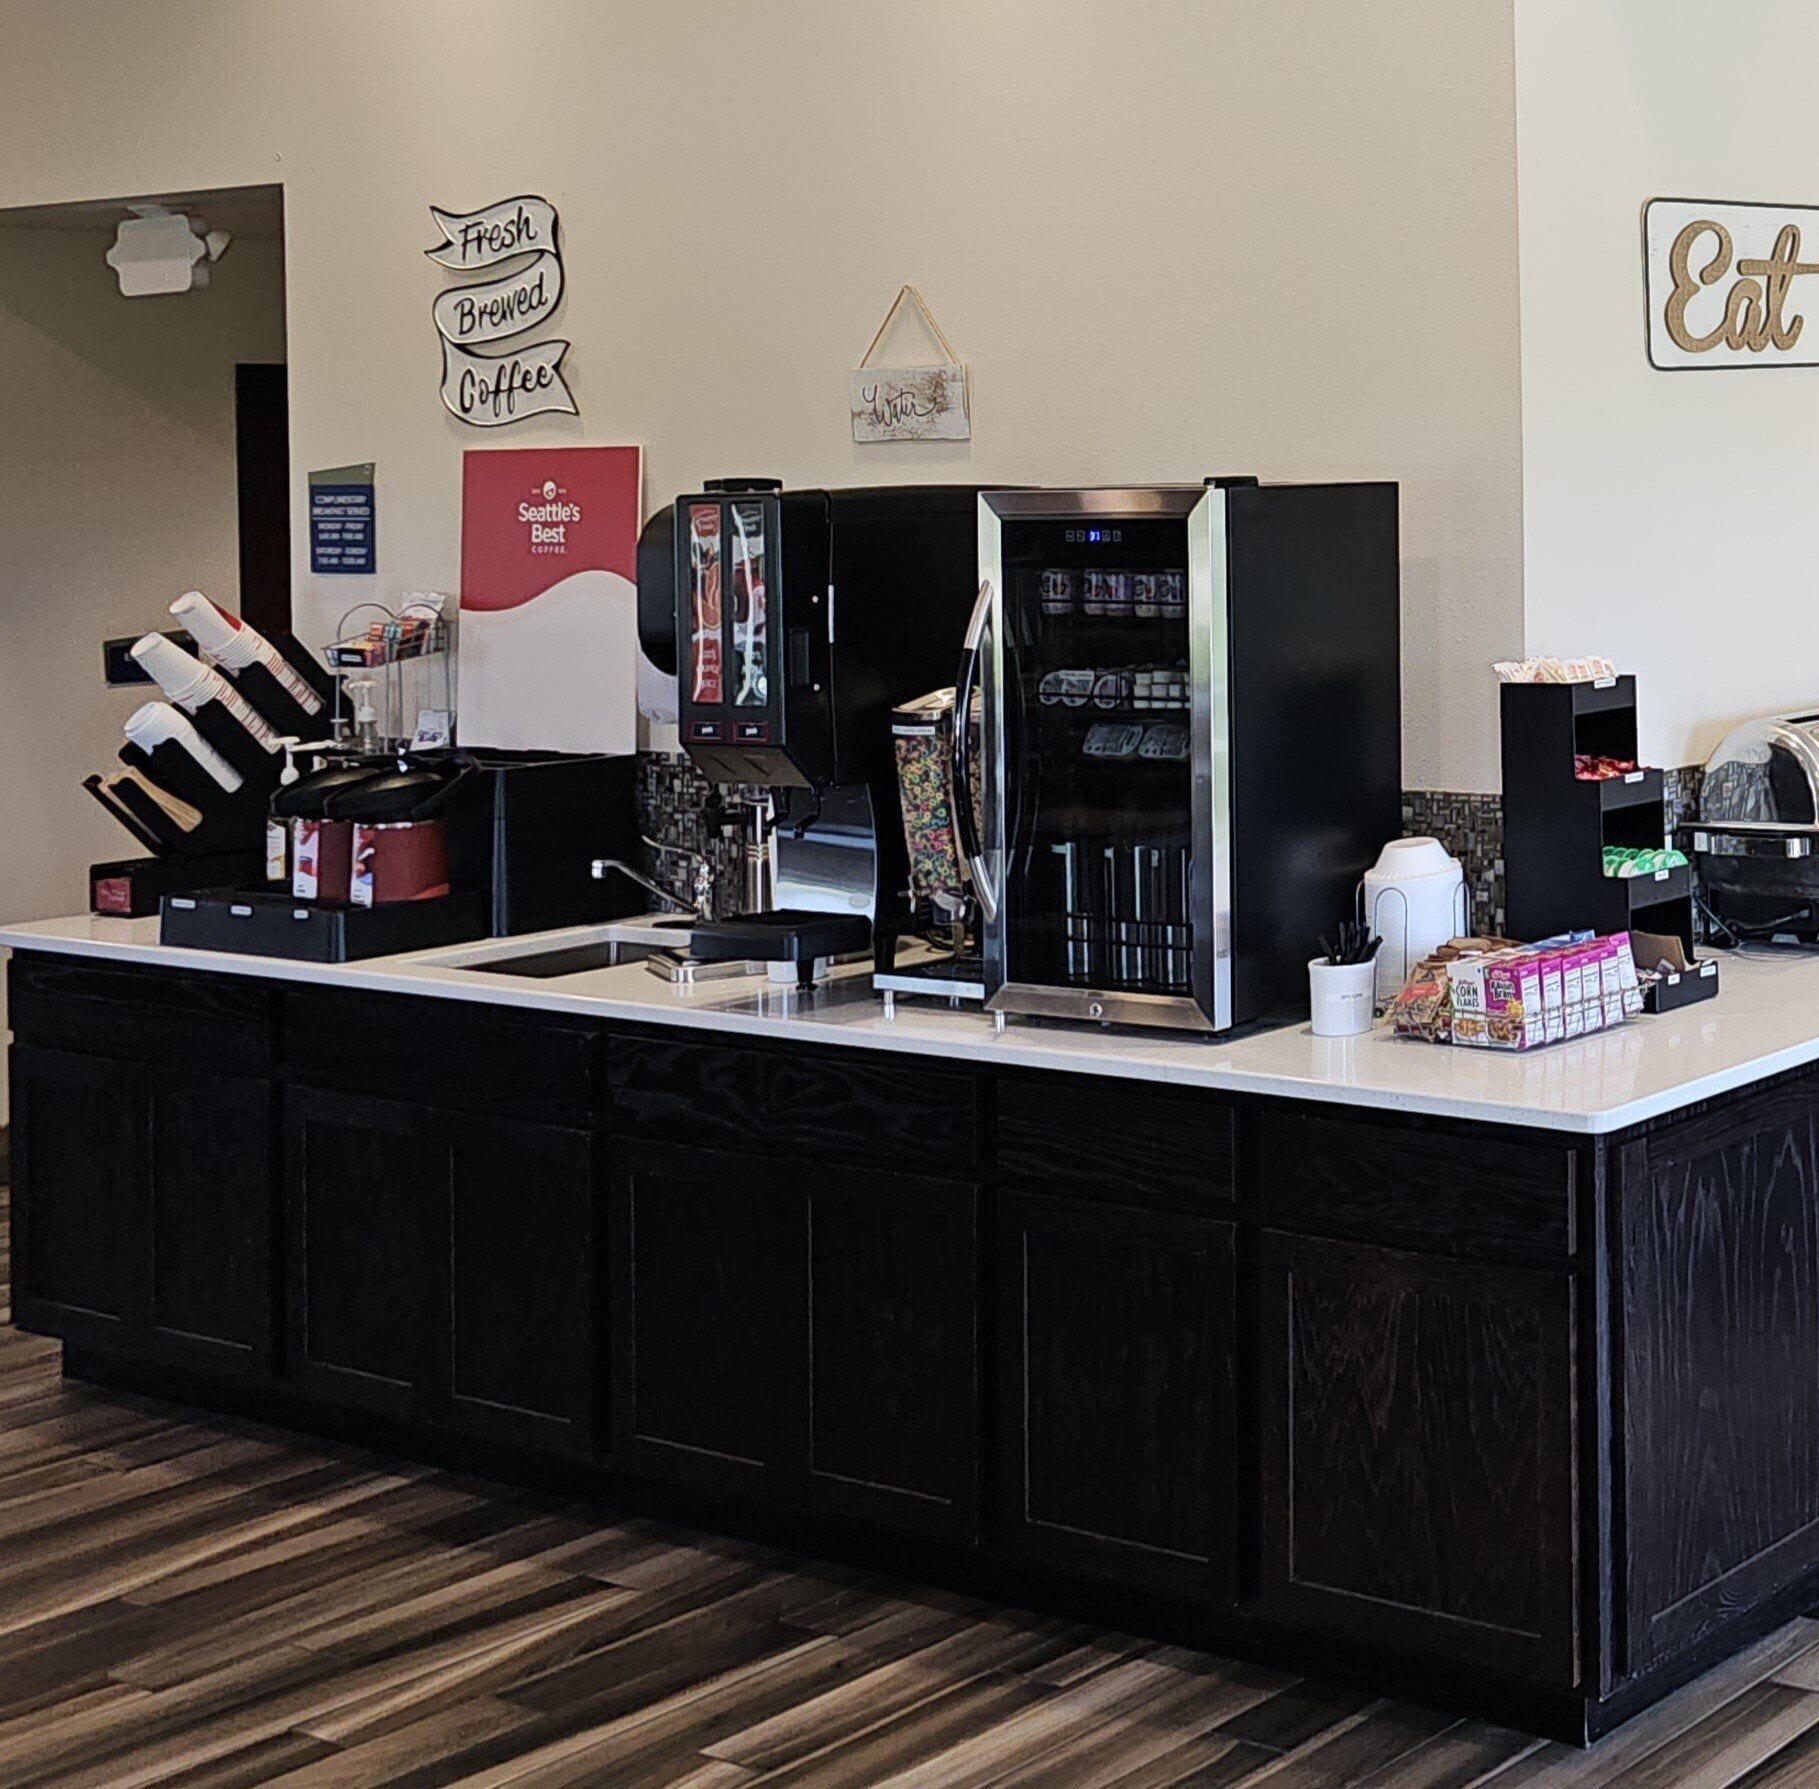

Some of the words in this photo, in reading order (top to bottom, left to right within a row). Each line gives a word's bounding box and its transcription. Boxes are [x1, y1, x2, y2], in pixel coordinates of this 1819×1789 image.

[458, 205, 538, 261] Fresh
[453, 271, 549, 335] Brewed
[459, 360, 554, 418] Coffee
[518, 502, 581, 522] Seattle's
[531, 524, 567, 542] Best
[1455, 985, 1479, 997] CORN
[1457, 997, 1480, 1007] FLAKES
